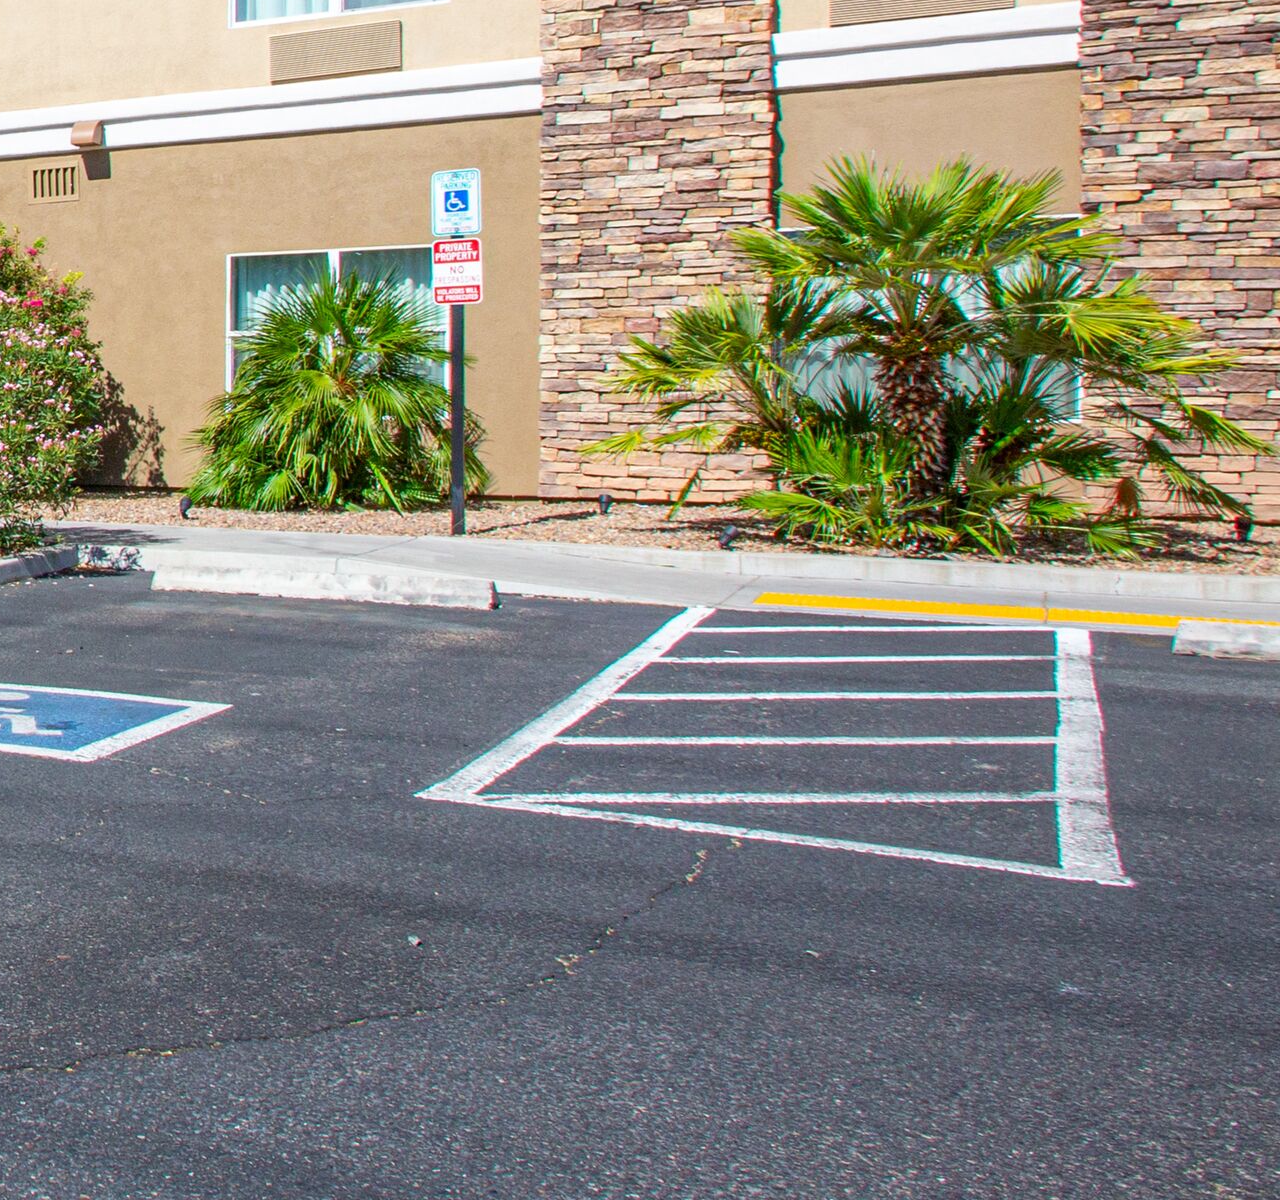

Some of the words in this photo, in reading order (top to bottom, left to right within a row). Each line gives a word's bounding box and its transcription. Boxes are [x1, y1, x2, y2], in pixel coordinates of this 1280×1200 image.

[439, 241, 473, 253] PRIVATE
[435, 250, 478, 262] PROPERTY
[449, 265, 465, 274] NO
[434, 274, 481, 284] TRESPASSING
